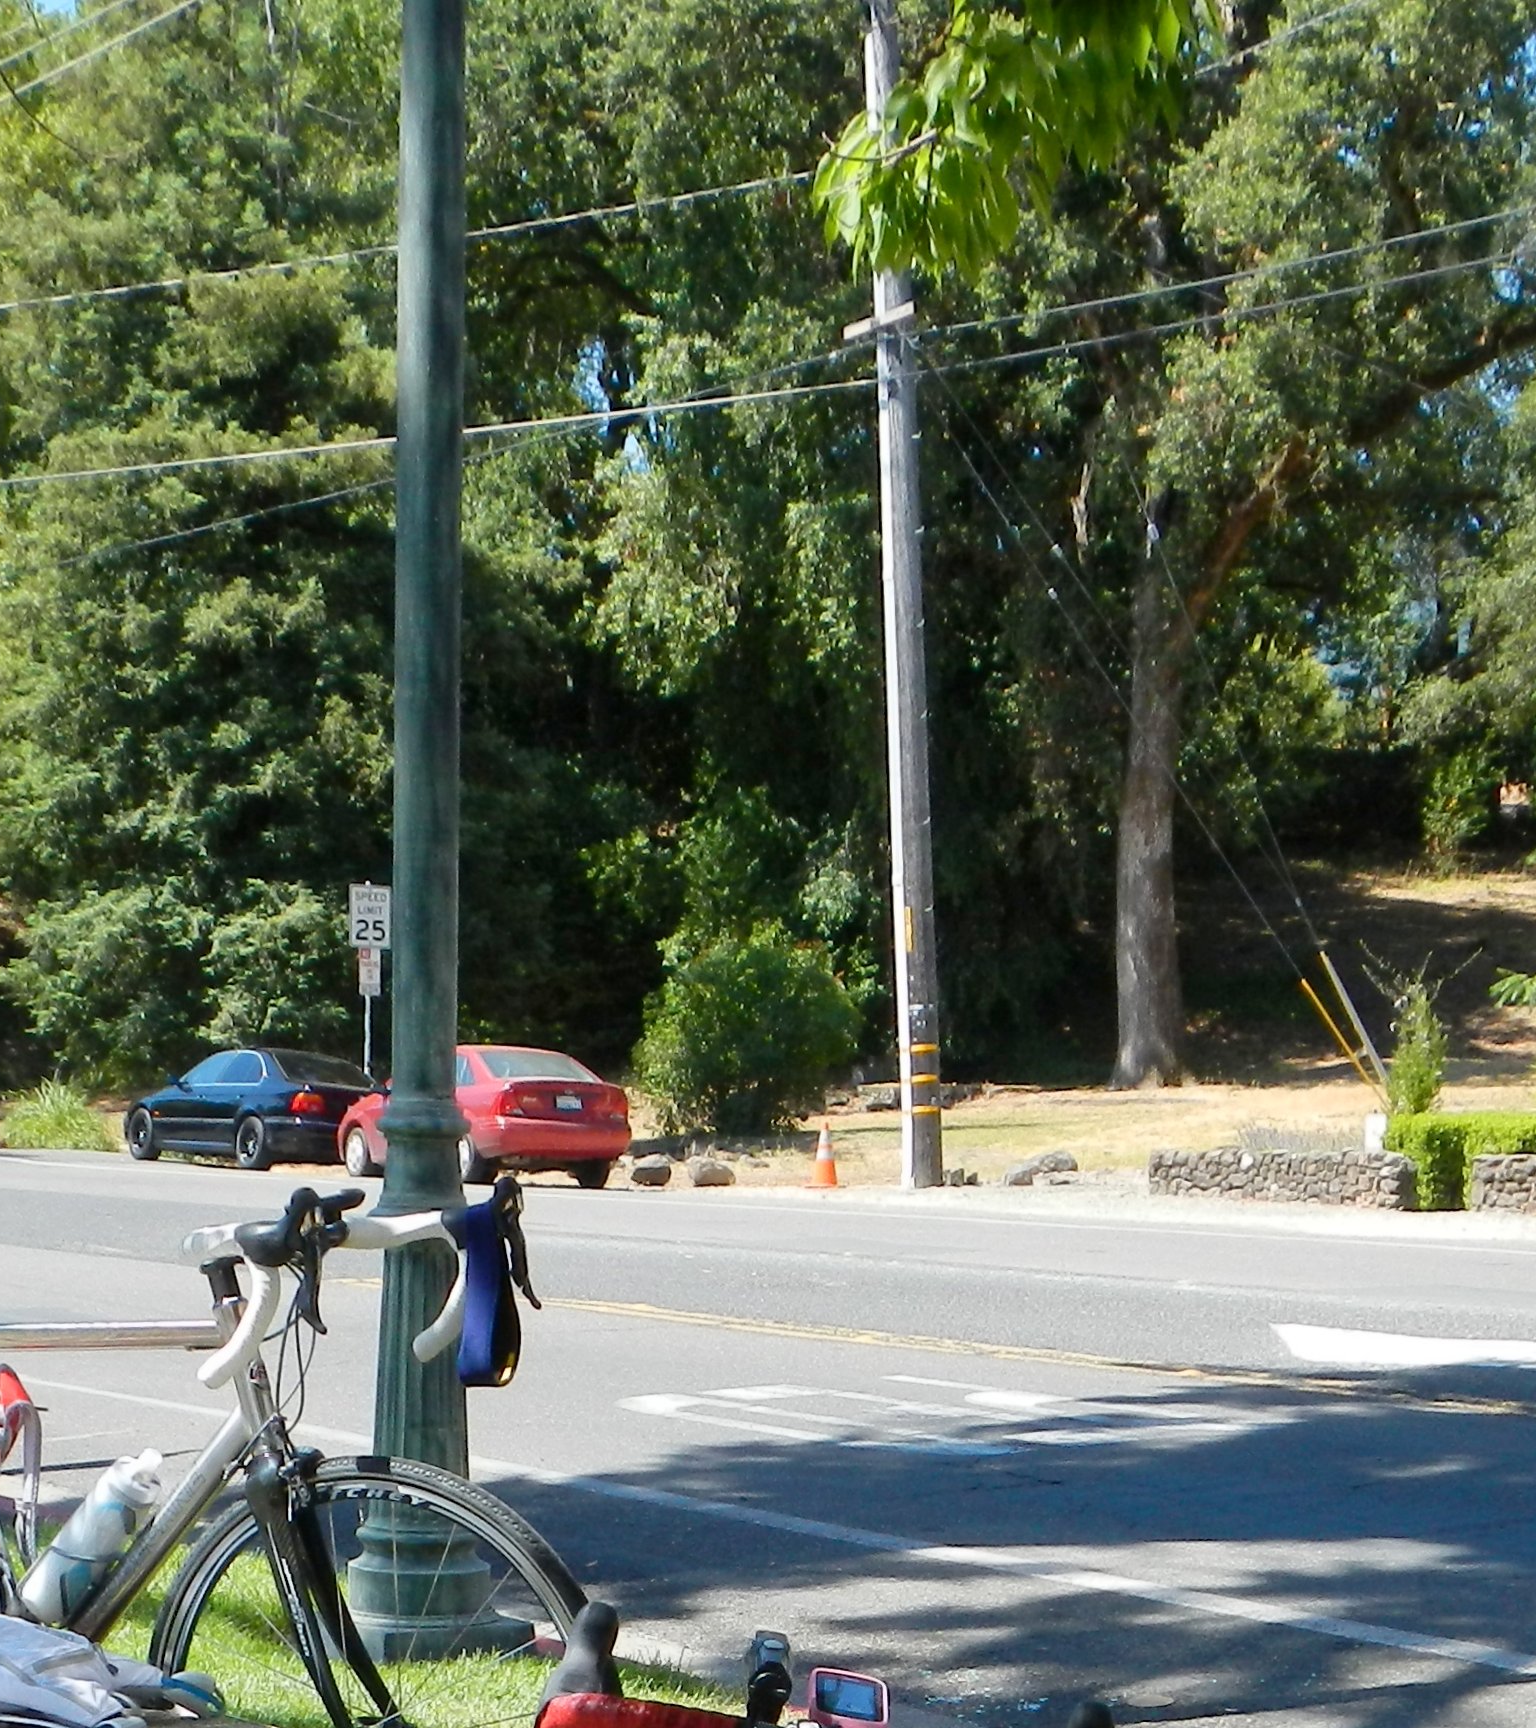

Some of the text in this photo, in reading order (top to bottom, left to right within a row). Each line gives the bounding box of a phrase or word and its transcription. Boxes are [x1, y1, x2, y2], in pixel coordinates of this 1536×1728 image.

[354, 891, 387, 903] SPEED
[357, 905, 383, 915] LIMIT
[355, 919, 386, 941] 25
